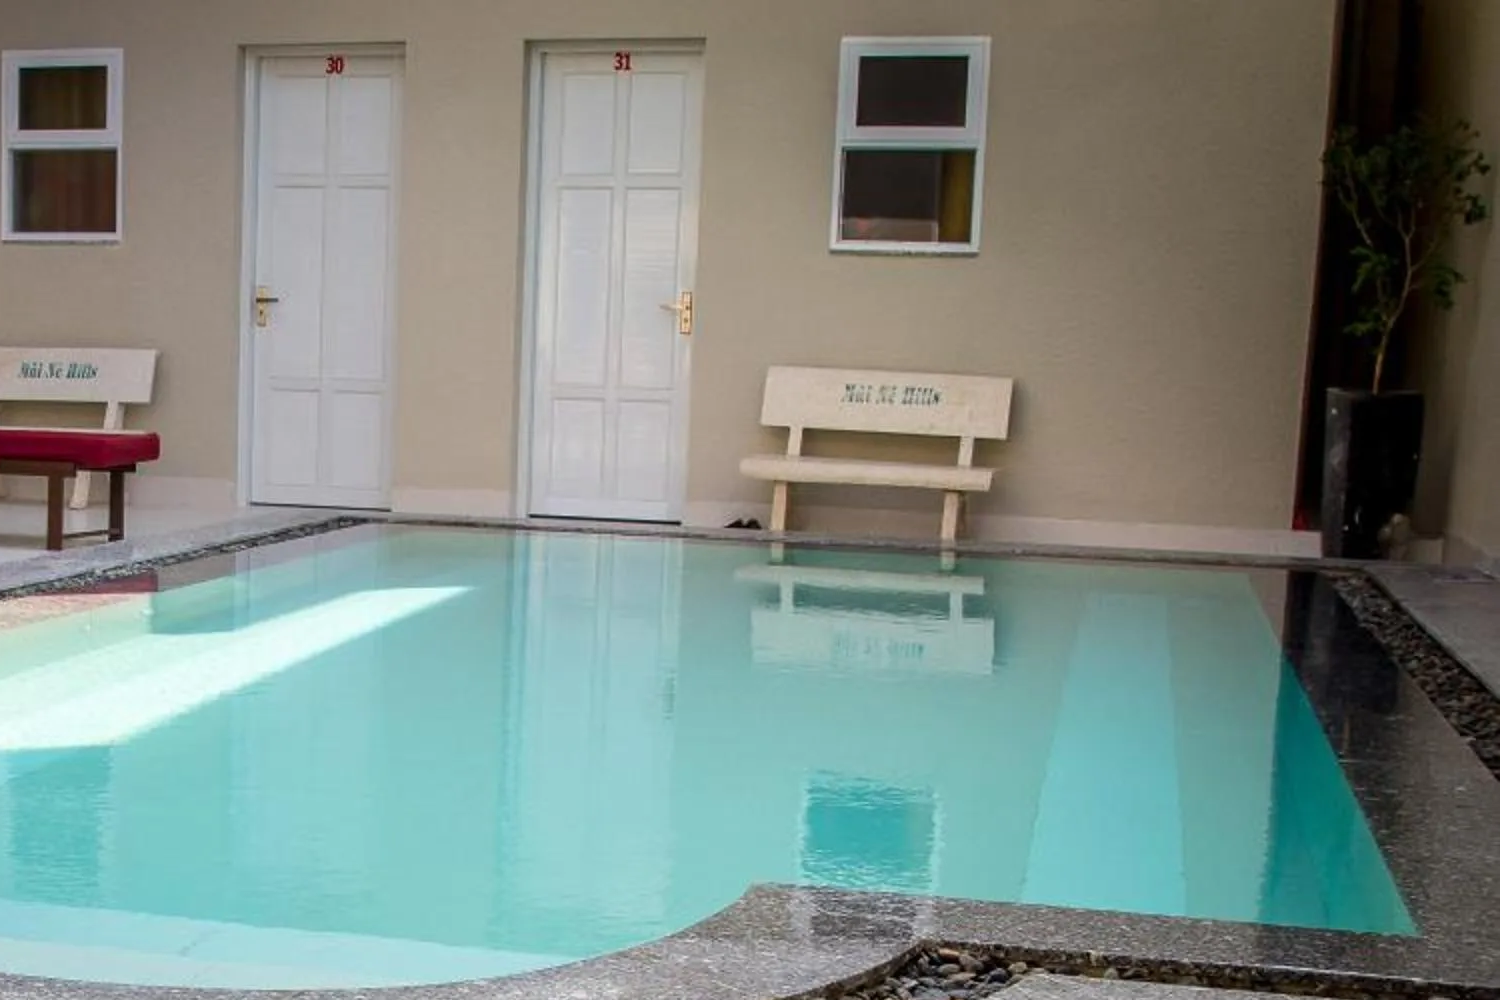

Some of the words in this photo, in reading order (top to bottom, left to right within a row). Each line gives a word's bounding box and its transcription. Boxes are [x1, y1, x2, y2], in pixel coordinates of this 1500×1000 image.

[325, 57, 344, 74] 30
[614, 51, 631, 70] 31
[65, 363, 98, 379] Hills
